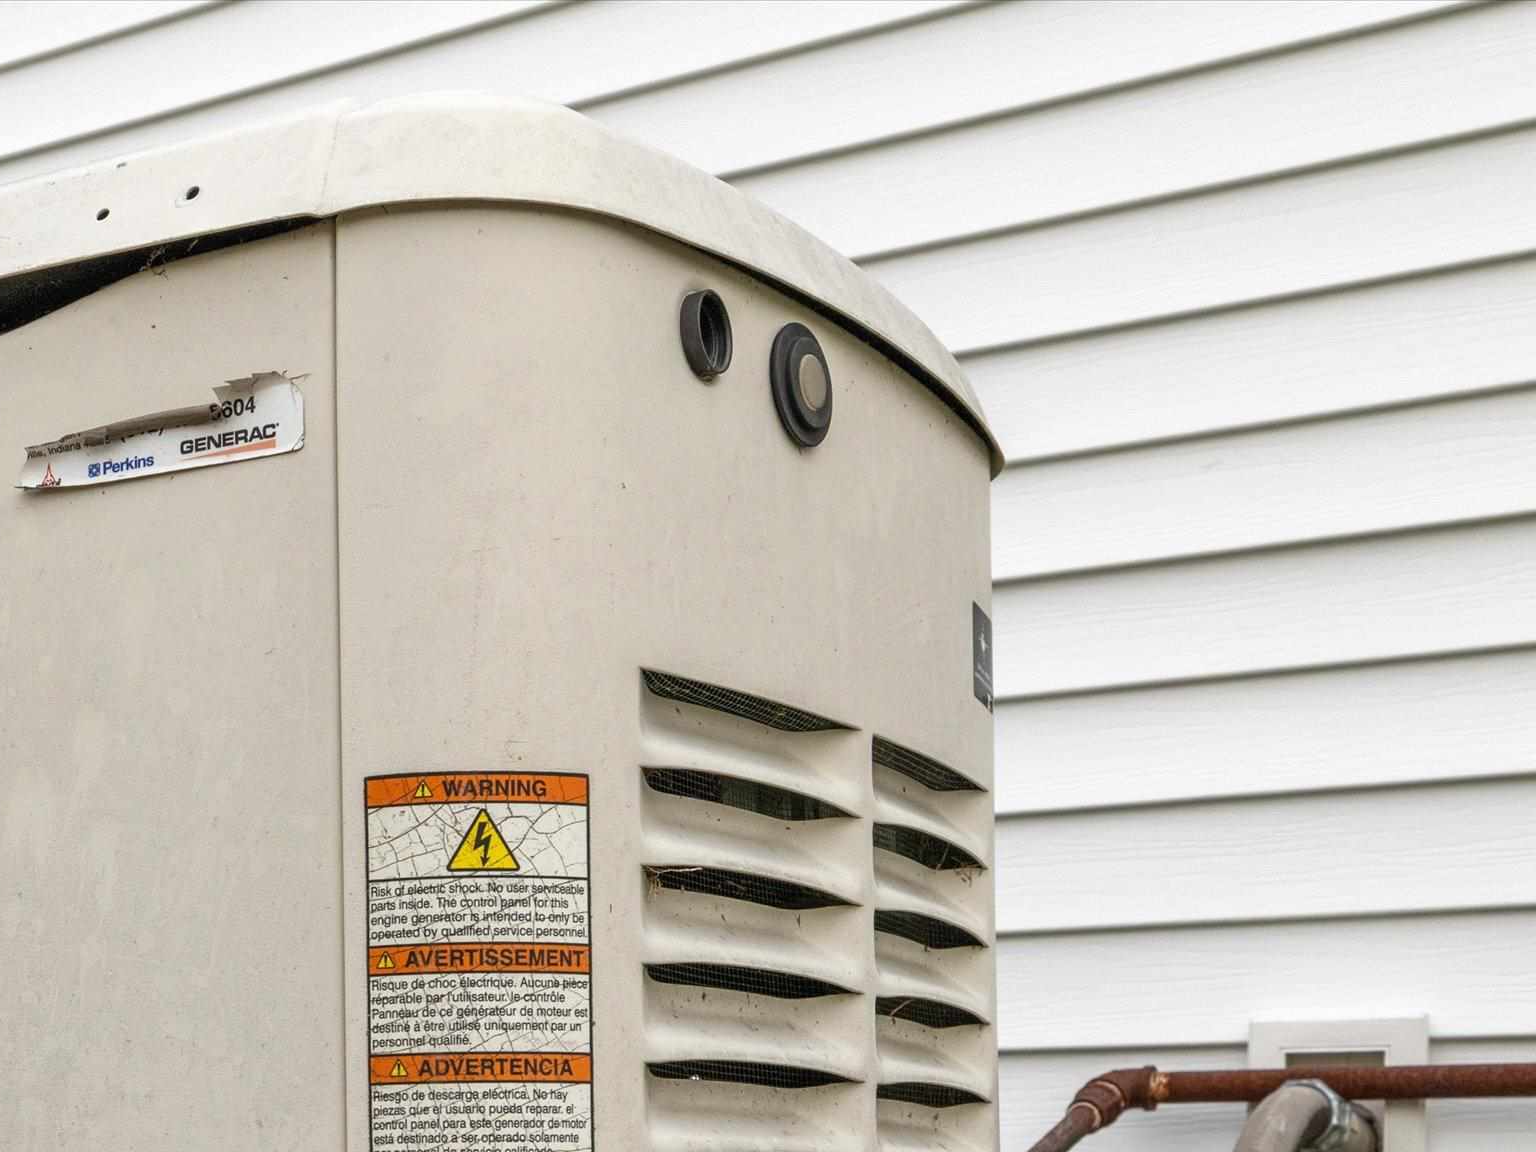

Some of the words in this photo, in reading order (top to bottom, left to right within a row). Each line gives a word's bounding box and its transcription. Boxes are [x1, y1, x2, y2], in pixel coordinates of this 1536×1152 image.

[103, 456, 154, 475] Perkins
[442, 780, 546, 796] WARNING
[371, 886, 391, 896] Risk
[395, 885, 404, 895] of
[407, 884, 445, 894] electric
[488, 883, 503, 893] No
[506, 884, 528, 893] user
[371, 899, 395, 913] parts
[437, 897, 456, 908] The
[460, 897, 496, 907] control
[501, 897, 530, 909] panel
[534, 897, 547, 908] for
[551, 897, 568, 908] this
[371, 913, 407, 927] engine
[411, 912, 465, 925] generator
[483, 911, 531, 922] intended
[547, 913, 569, 925] only
[572, 914, 584, 923] be
[371, 928, 419, 940] operated
[423, 927, 437, 938] by
[494, 926, 532, 937] service
[405, 950, 584, 967] AVERTISSEMENT
[372, 979, 407, 992] Risque
[411, 979, 425, 988] de
[428, 978, 456, 988] choc
[521, 977, 559, 988] Aucune
[427, 993, 443, 1004] par
[511, 992, 520, 1001] le
[373, 1008, 417, 1019] Panneau
[422, 1007, 435, 1017] de
[439, 1009, 453, 1017] ce
[520, 1007, 533, 1017] de
[537, 1008, 570, 1017] moteur
[575, 1009, 588, 1017] est
[484, 1022, 548, 1033] uniquement
[551, 1023, 567, 1032] par
[373, 1037, 425, 1049] personnel
[418, 1059, 573, 1076] ADVERTENCIA
[412, 1091, 424, 1100] de
[533, 1090, 546, 1099] No
[550, 1090, 567, 1102] hay
[409, 1106, 429, 1117] que
[445, 1104, 485, 1114] usuario
[489, 1105, 522, 1116] pueda
[374, 1120, 407, 1130] control
[410, 1119, 439, 1130] panel
[443, 1120, 466, 1130] para
[470, 1119, 492, 1128] este
[495, 1119, 544, 1130] generador
[548, 1119, 560, 1128] de
[561, 1120, 586, 1129] motor
[397, 1133, 447, 1144] destinado
[461, 1134, 478, 1143] ser
[481, 1133, 526, 1145] operado
[529, 1134, 579, 1143] solamente
